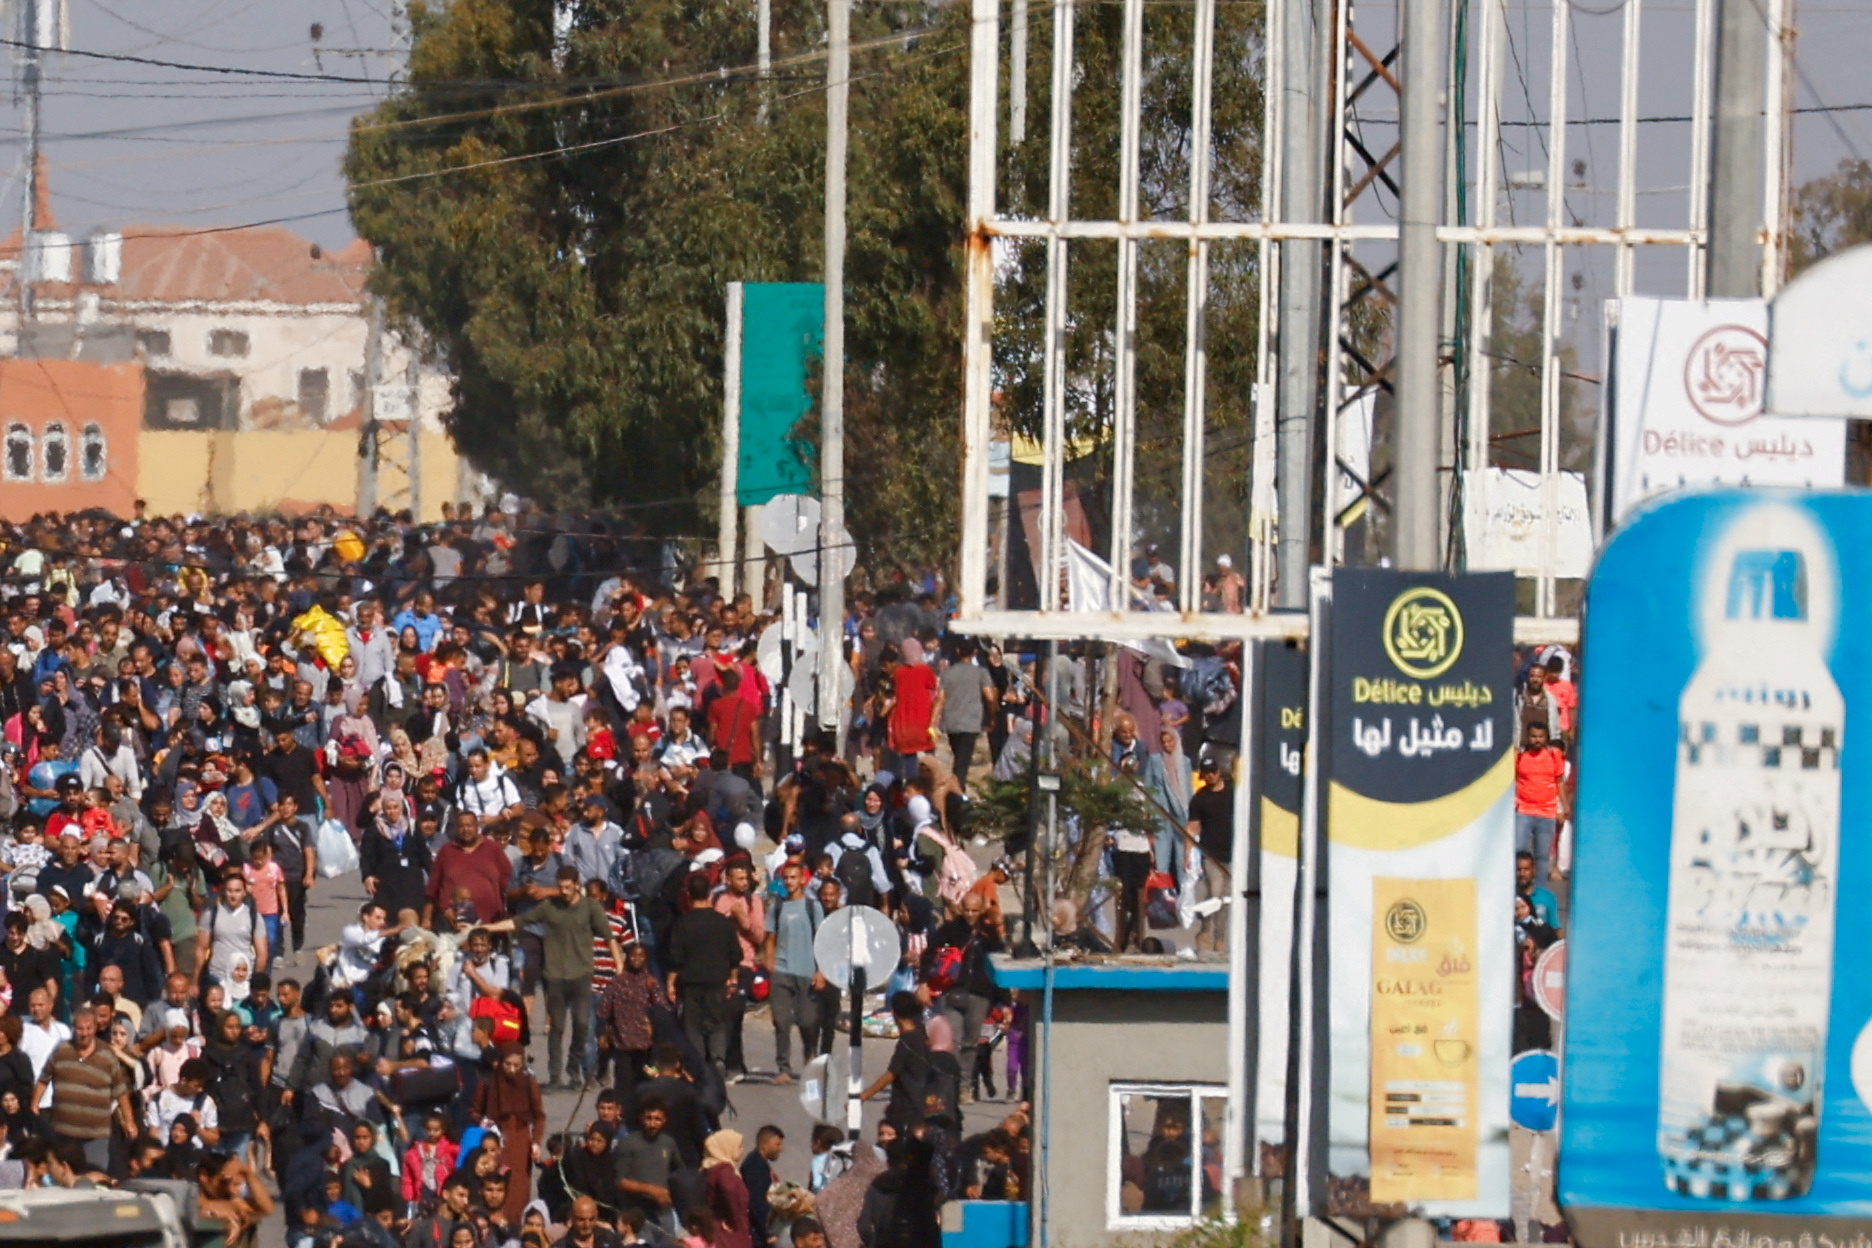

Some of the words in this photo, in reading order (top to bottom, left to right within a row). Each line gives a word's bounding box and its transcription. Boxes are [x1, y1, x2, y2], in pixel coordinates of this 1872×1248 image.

[1643, 430, 1724, 457] Délice
[1734, 435, 1814, 461] ديليس
[1354, 676, 1423, 703] Délice
[1428, 681, 1493, 708] ديليس
[1353, 717, 1392, 757] لها
[1398, 714, 1464, 757] مثيل
[1470, 717, 1494, 750] لا
